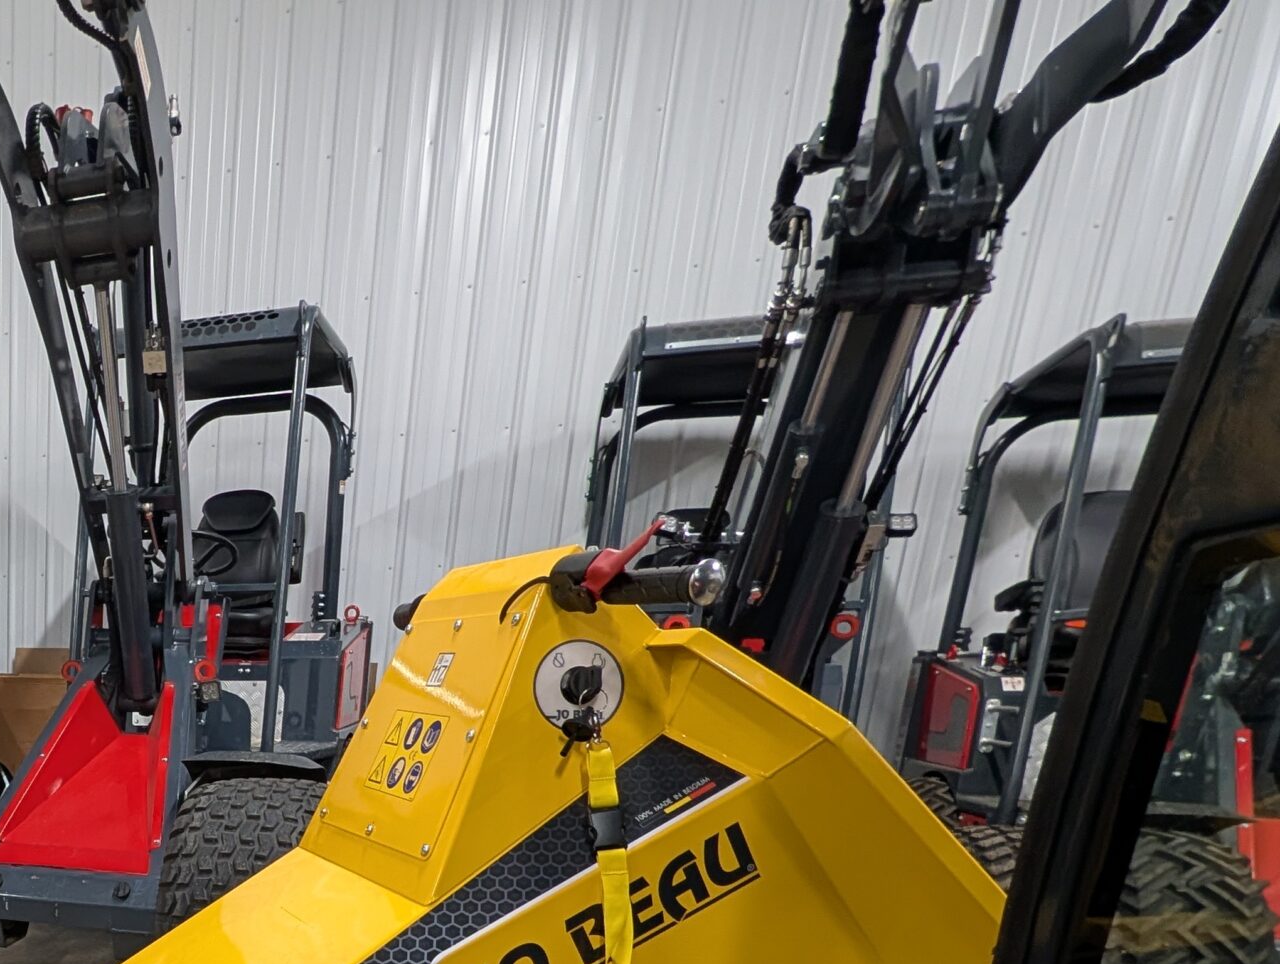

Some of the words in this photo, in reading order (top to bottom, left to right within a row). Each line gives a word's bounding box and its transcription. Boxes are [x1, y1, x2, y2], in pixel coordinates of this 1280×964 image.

[556, 709, 570, 721] JO
[634, 809, 654, 822] 100%
[653, 797, 673, 811] MADE
[682, 776, 711, 795] BELGIUM
